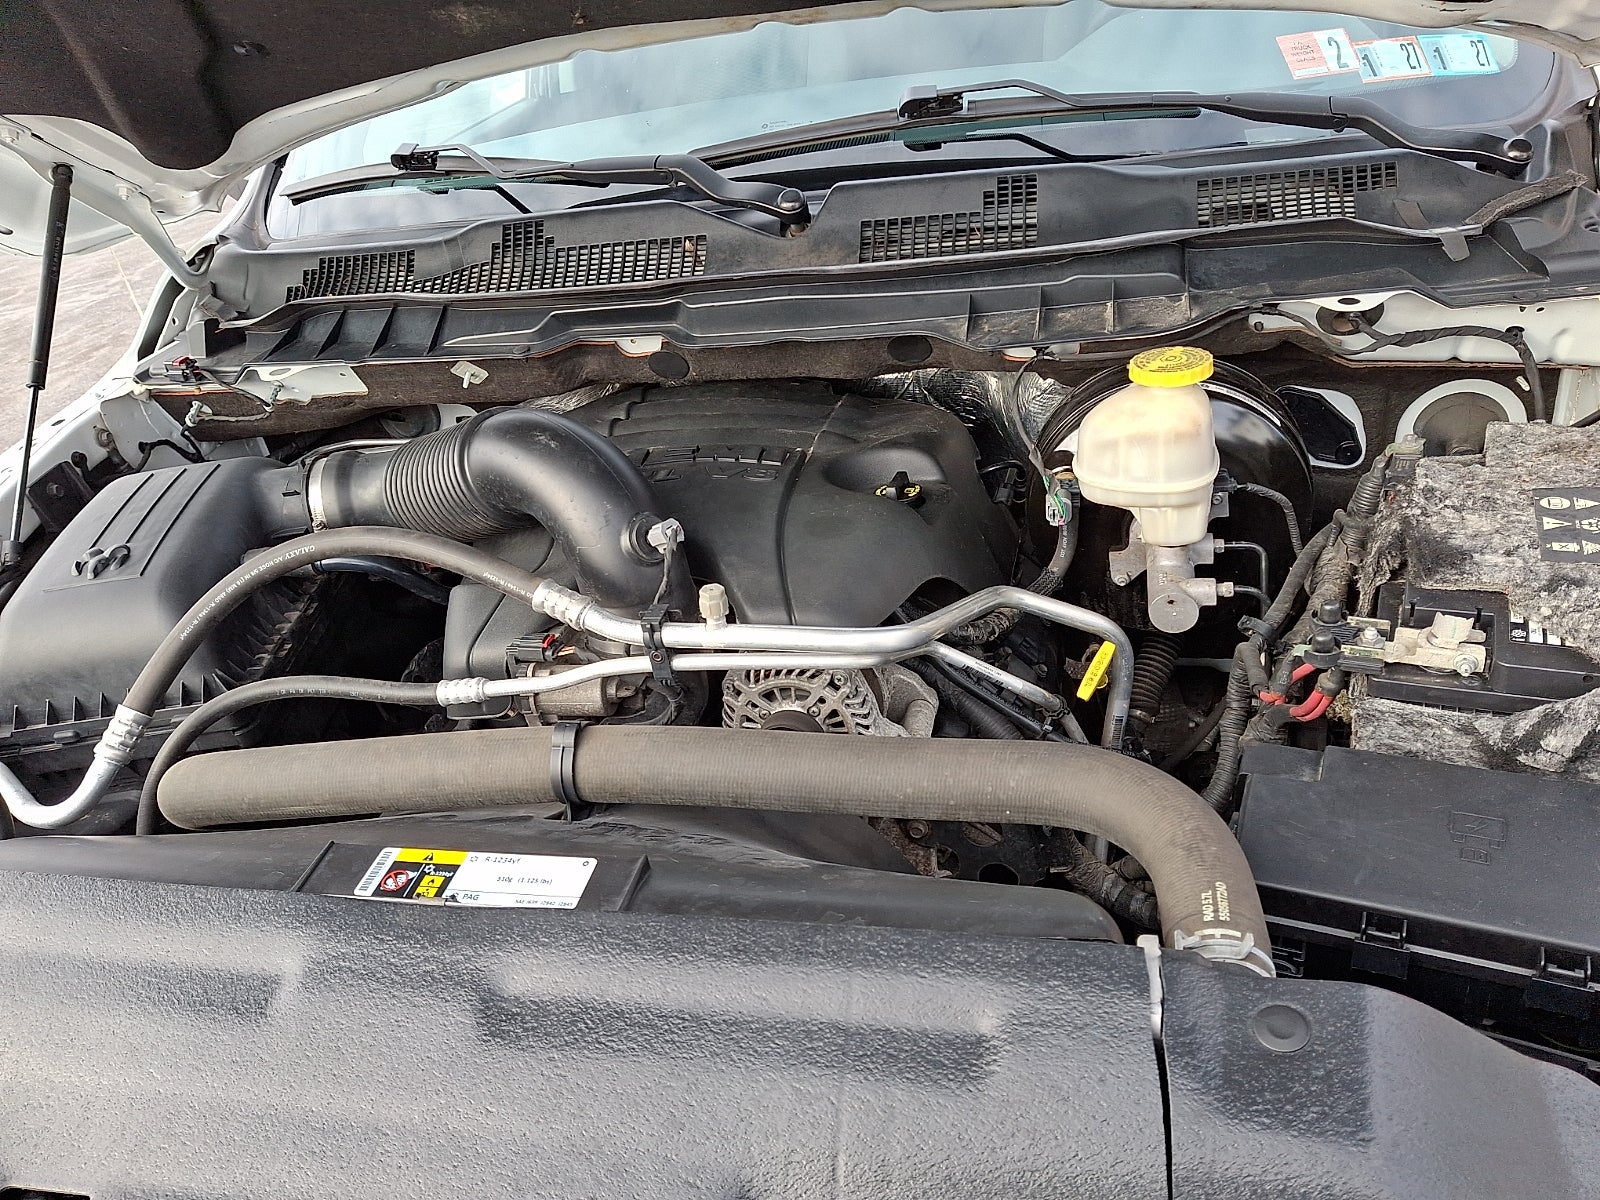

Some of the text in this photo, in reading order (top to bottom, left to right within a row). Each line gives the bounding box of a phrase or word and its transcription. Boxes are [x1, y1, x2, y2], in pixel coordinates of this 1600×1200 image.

[1327, 36, 1350, 69] 2
[1361, 53, 1378, 77] 1
[1399, 42, 1422, 70] 27
[1432, 39, 1491, 71] 1 27
[273, 555, 284, 564] A/C
[285, 544, 316, 561] GALAXY
[257, 561, 275, 572] HOSE
[484, 856, 521, 865] R-1234yf
[462, 893, 480, 901] PAG
[1203, 905, 1214, 921] RAD
